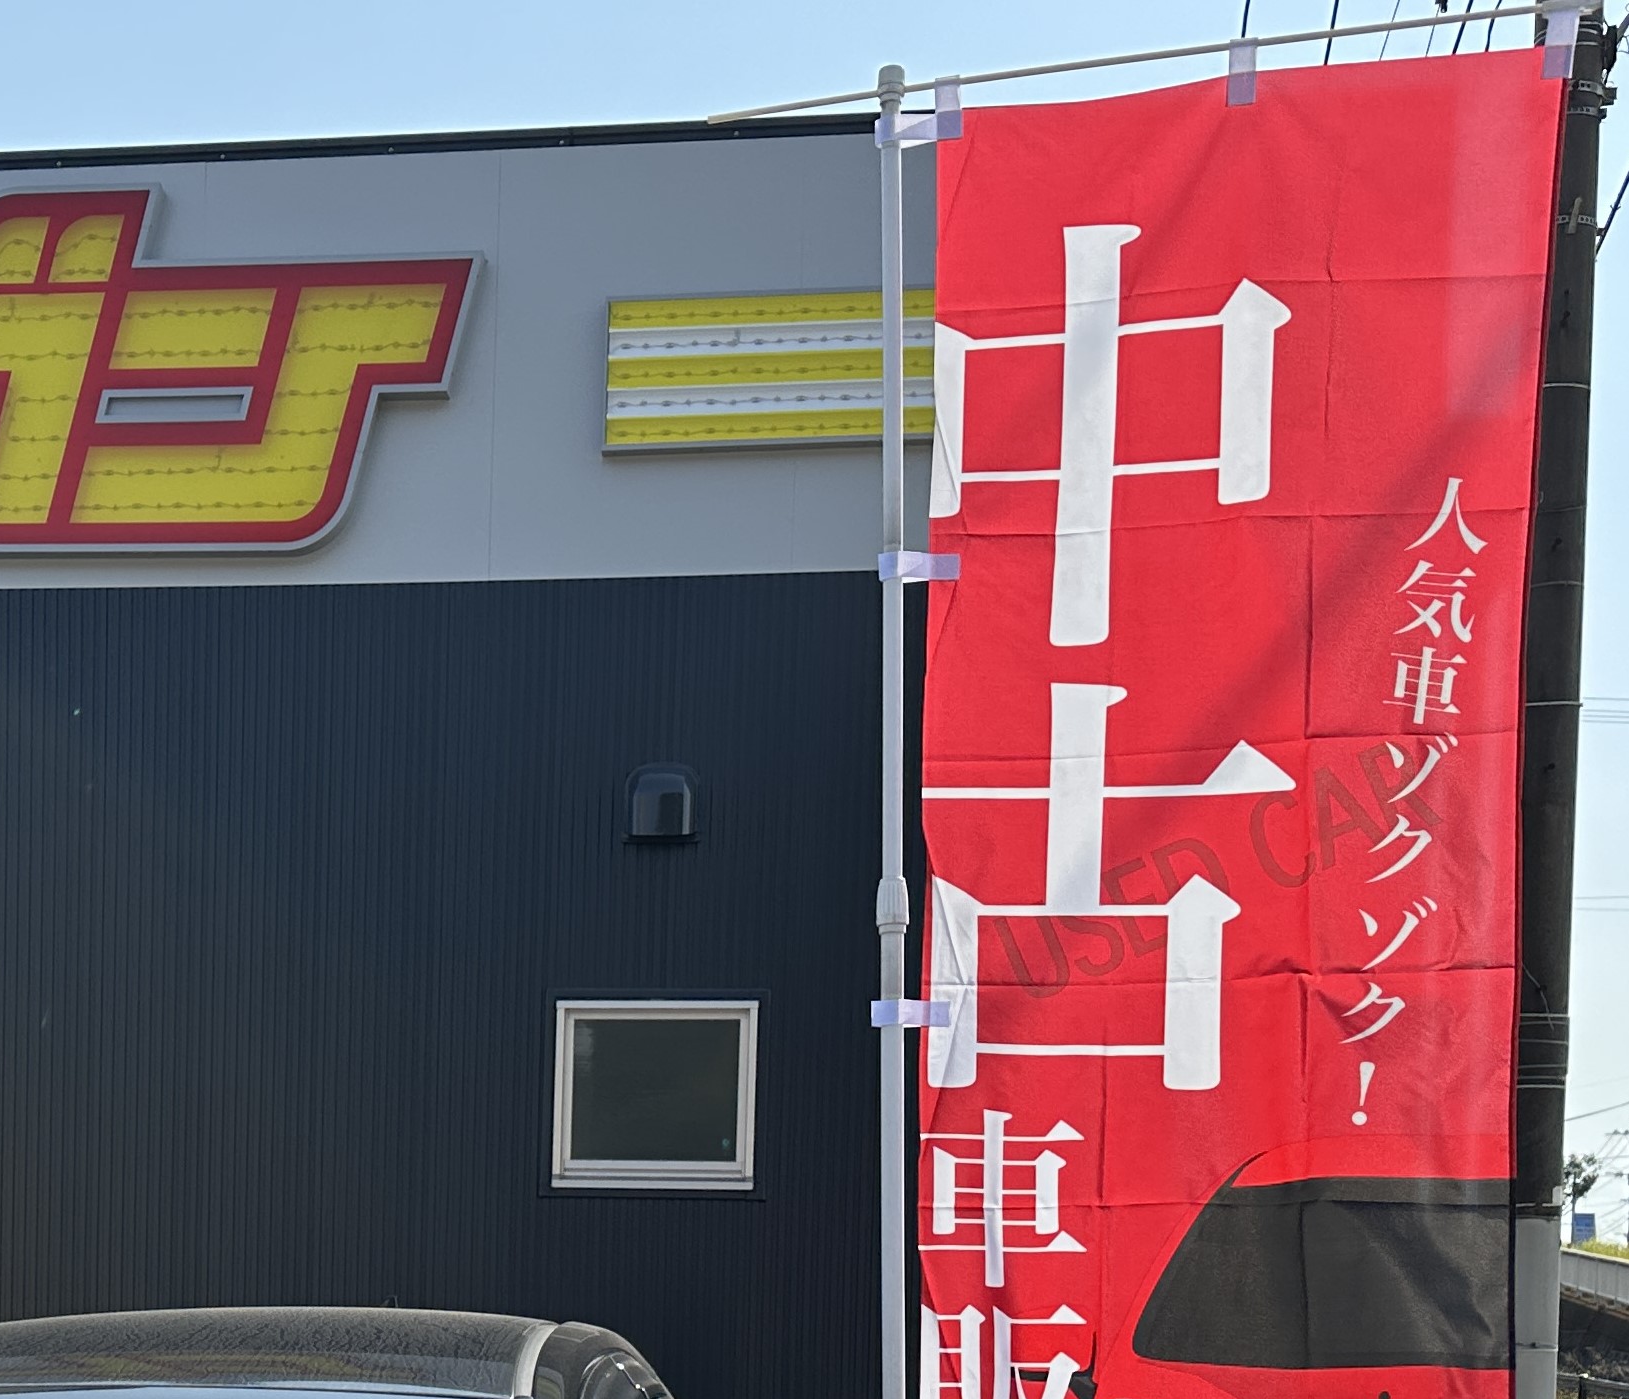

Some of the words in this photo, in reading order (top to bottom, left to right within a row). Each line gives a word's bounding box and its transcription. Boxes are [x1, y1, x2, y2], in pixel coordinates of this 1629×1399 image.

[1247, 740, 1443, 889] CAR
[1339, 476, 1489, 1127] 人気車ゾクゾク！
